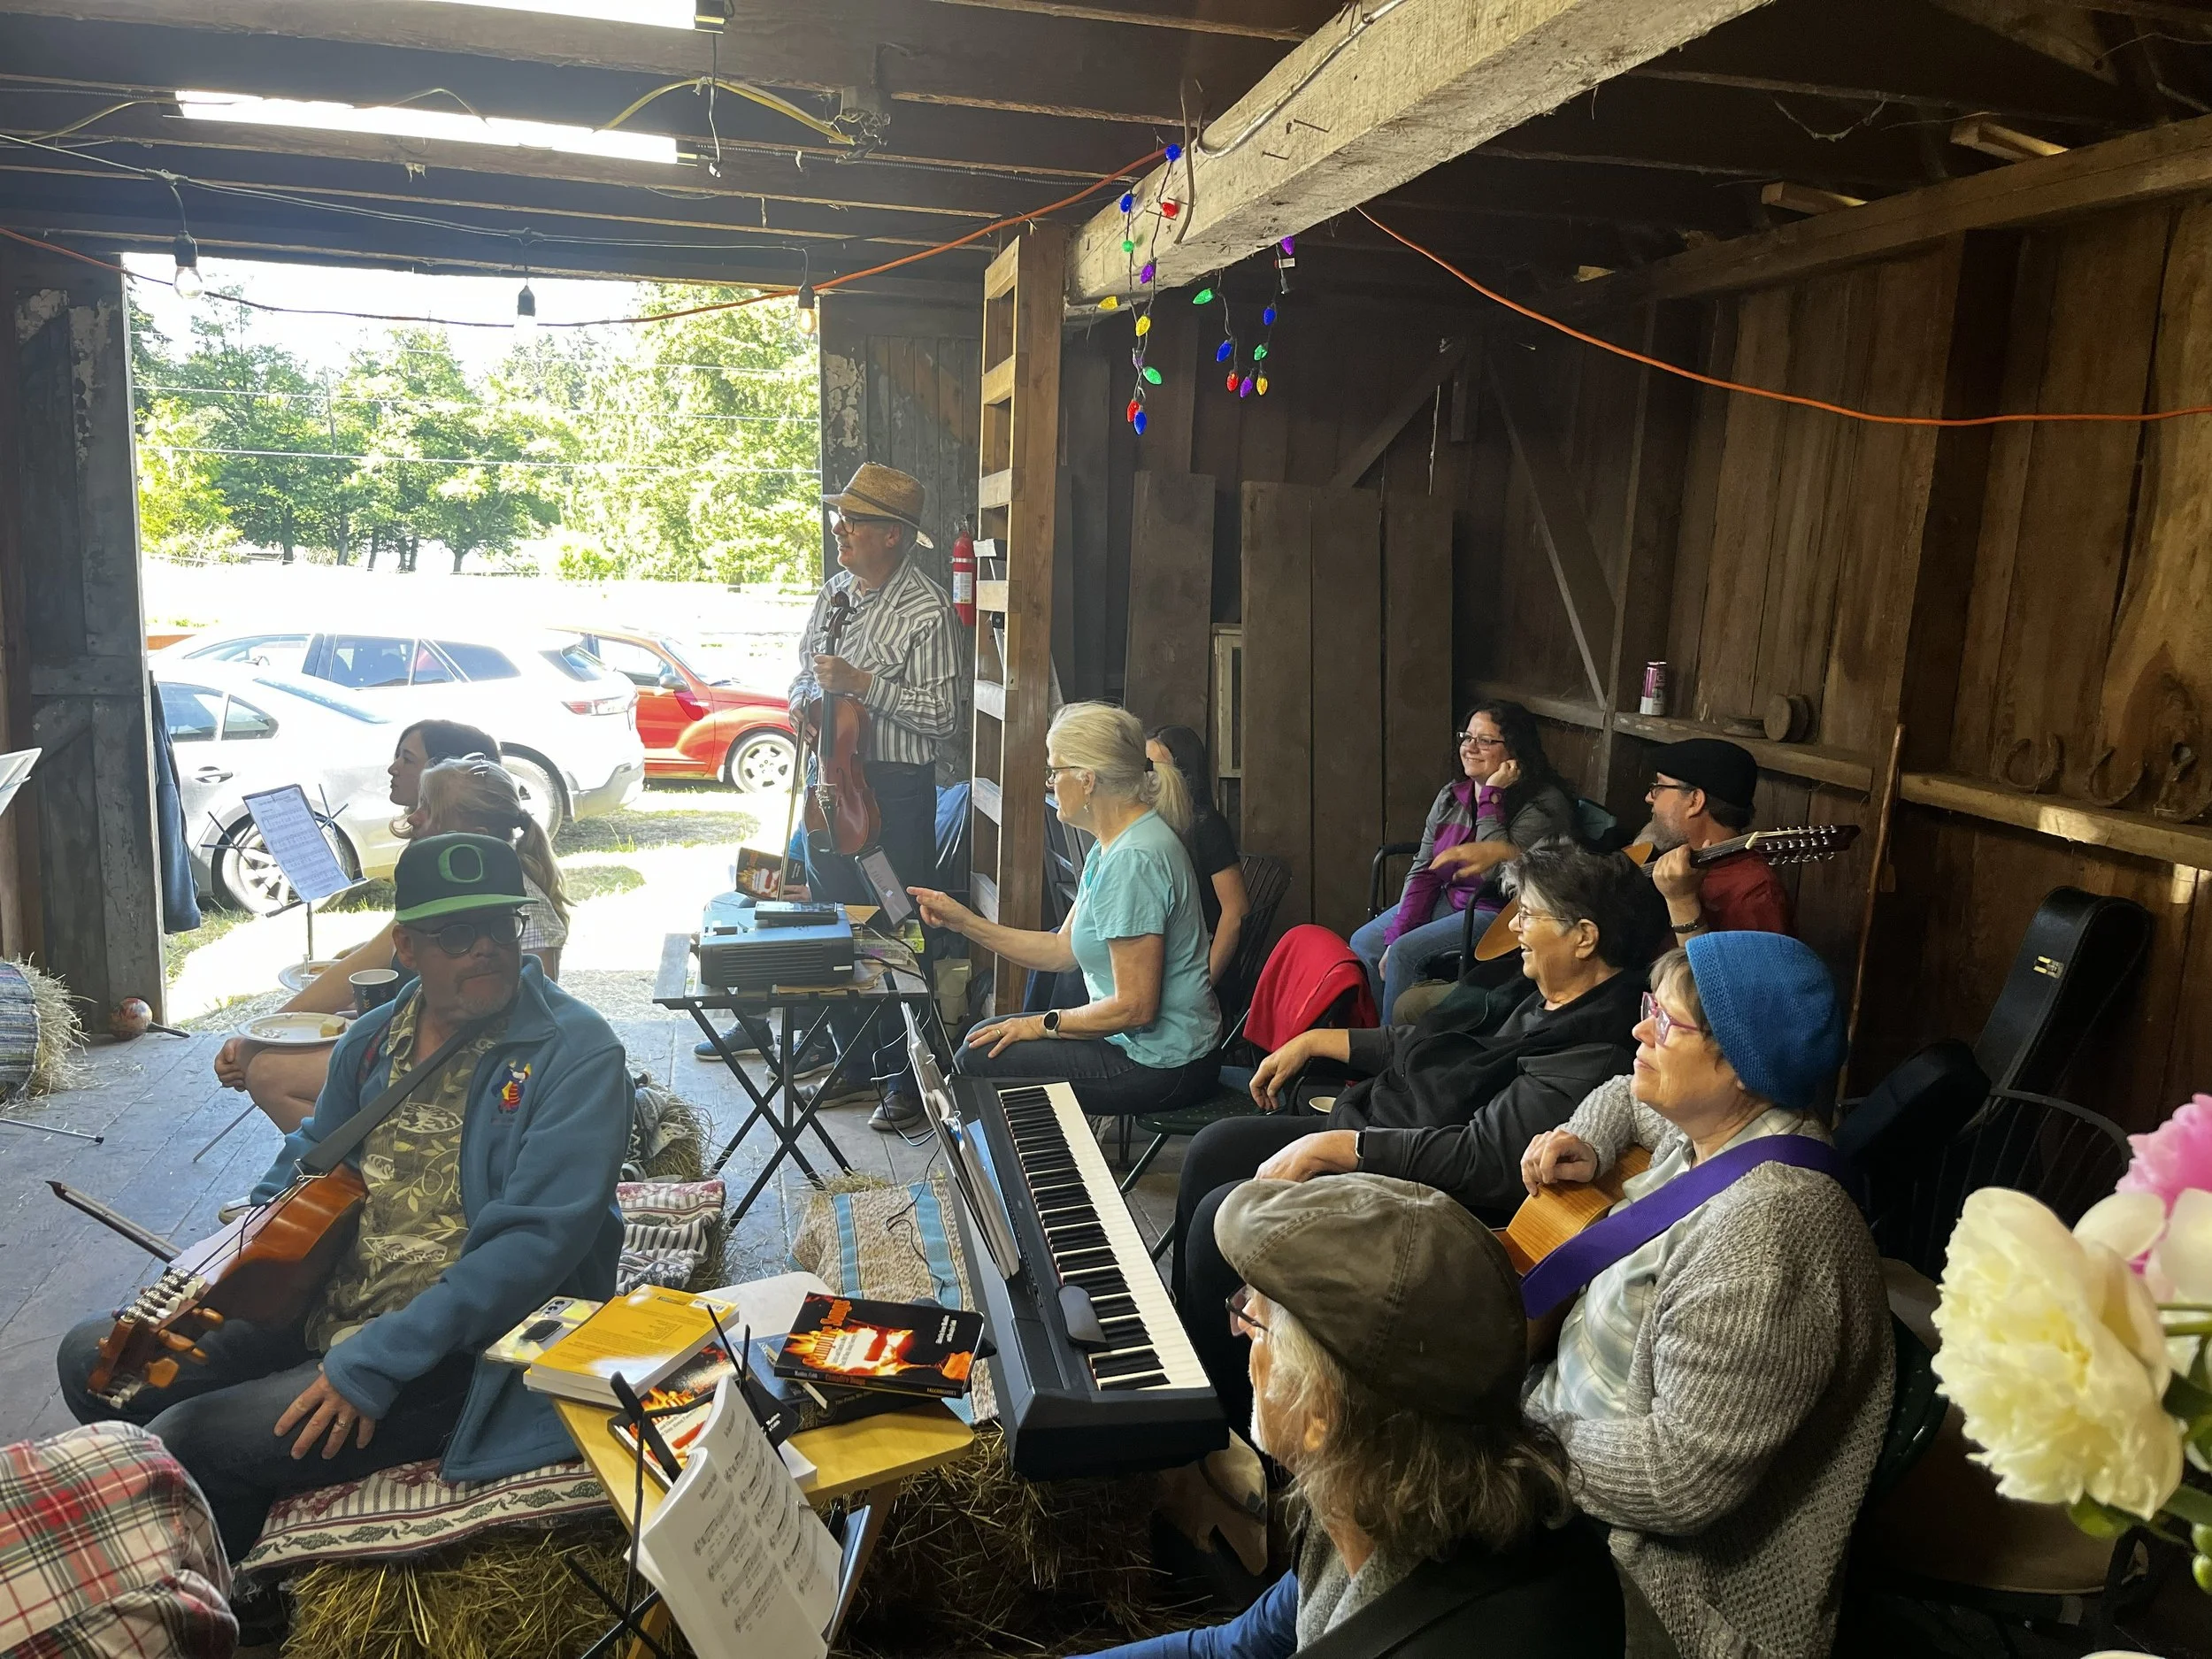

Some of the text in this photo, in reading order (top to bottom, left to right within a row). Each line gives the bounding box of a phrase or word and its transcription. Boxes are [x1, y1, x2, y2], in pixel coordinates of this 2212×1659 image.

[438, 843, 485, 883] O
[820, 1299, 853, 1327] Songs
[803, 1325, 841, 1366] Campfire
